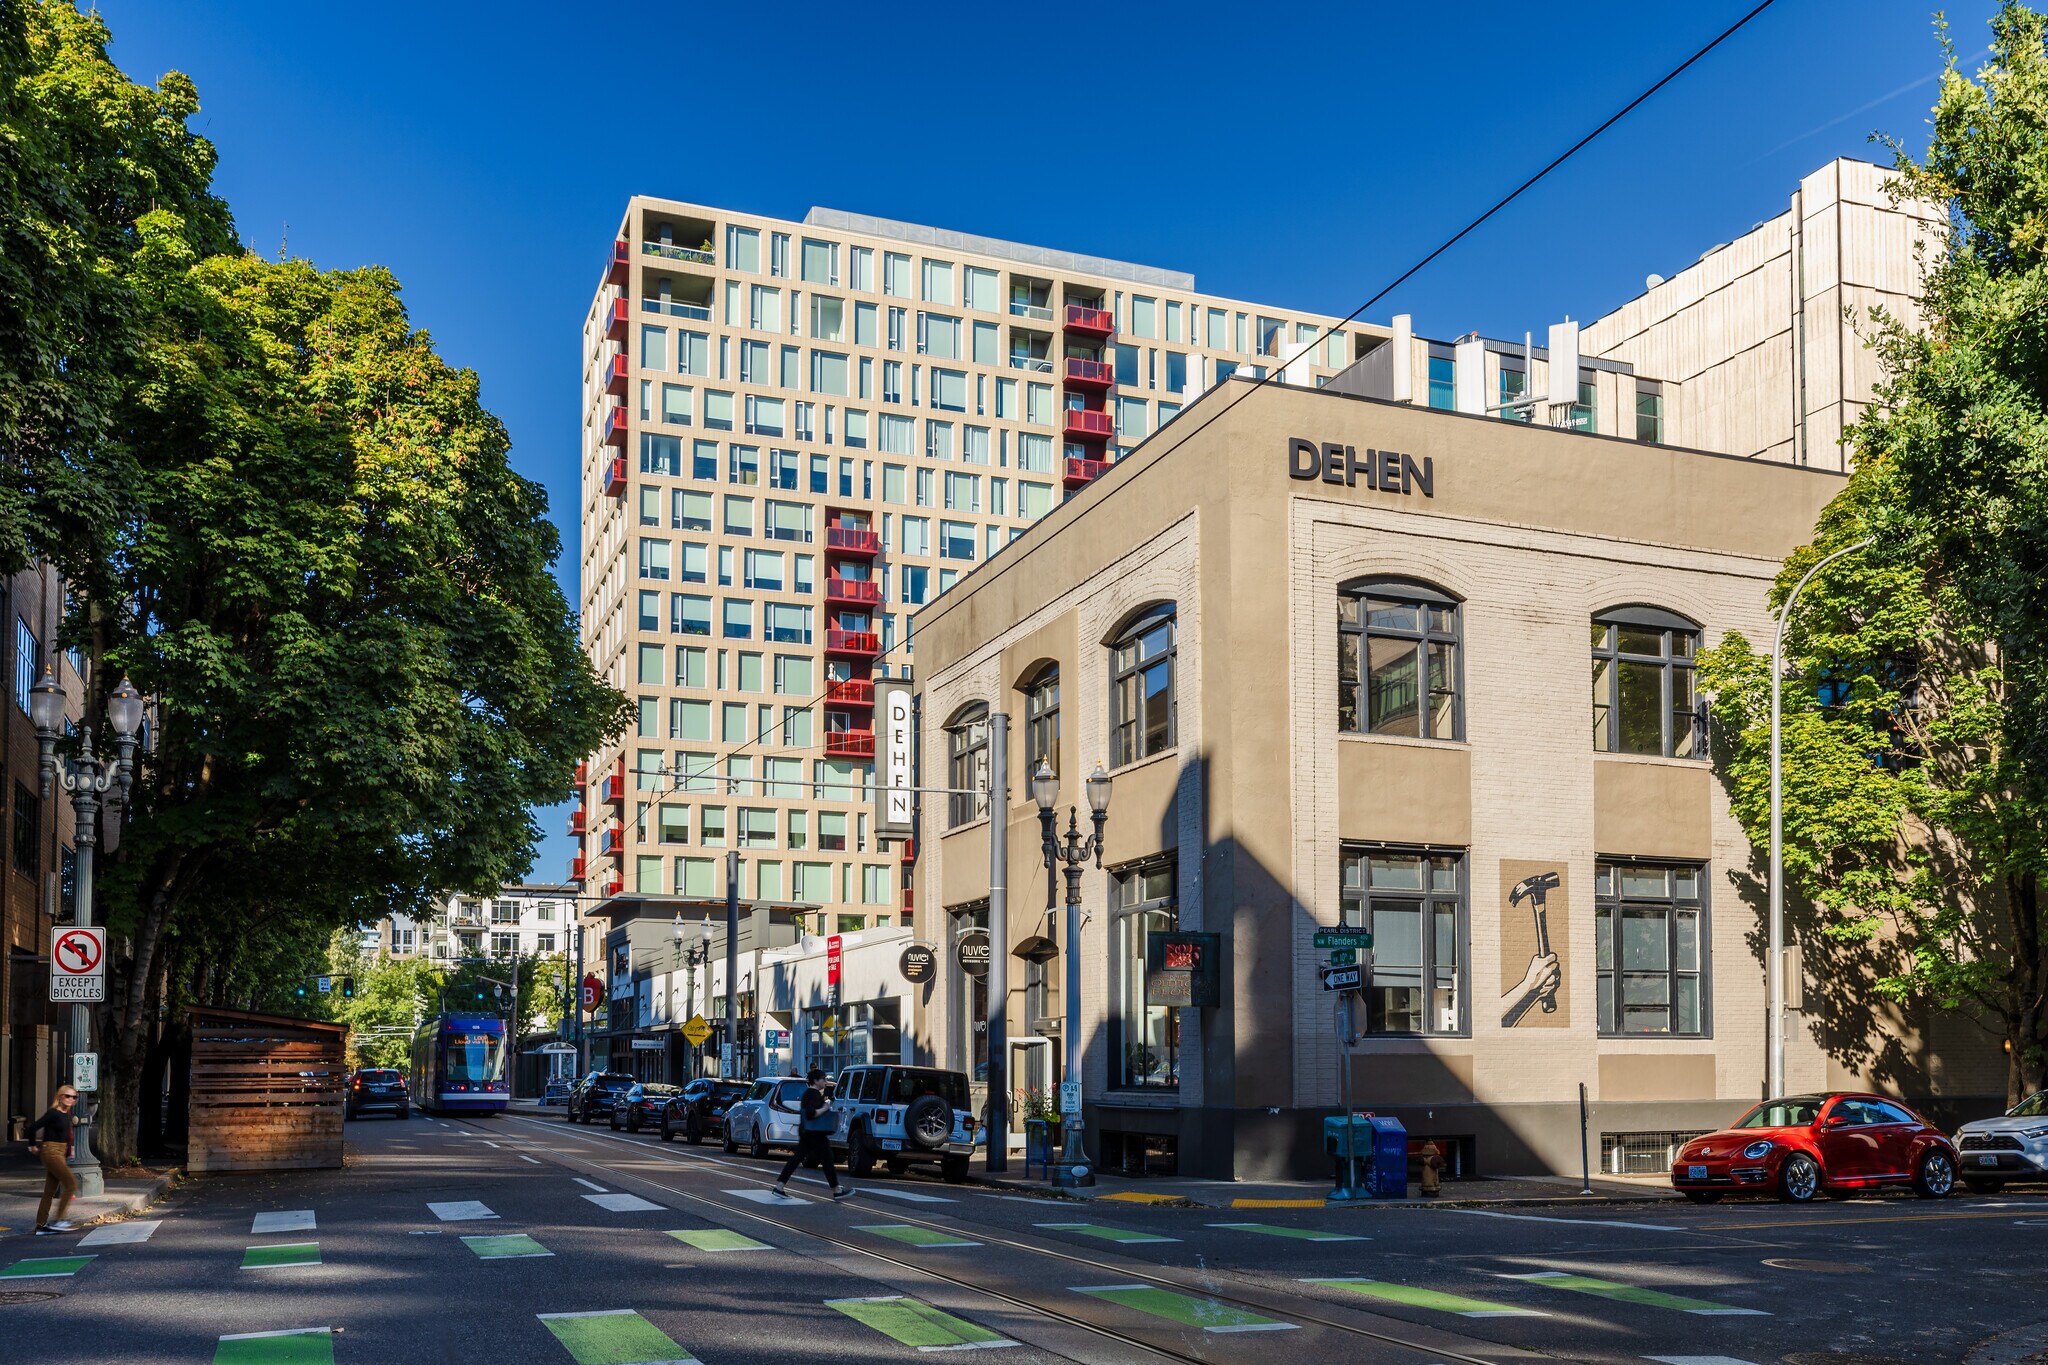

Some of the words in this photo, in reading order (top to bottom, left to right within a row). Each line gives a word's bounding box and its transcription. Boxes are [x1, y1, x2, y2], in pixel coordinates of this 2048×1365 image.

[1288, 437, 1434, 498] DEHEN
[893, 706, 906, 812] DEHEN
[1327, 936, 1357, 946] Flanders
[962, 944, 990, 956] nuvre
[59, 977, 96, 987] EXCEPT
[1333, 973, 1344, 983] ONE
[1345, 971, 1357, 982] WAY
[53, 988, 101, 998] BICYCLES
[583, 987, 594, 1004] B
